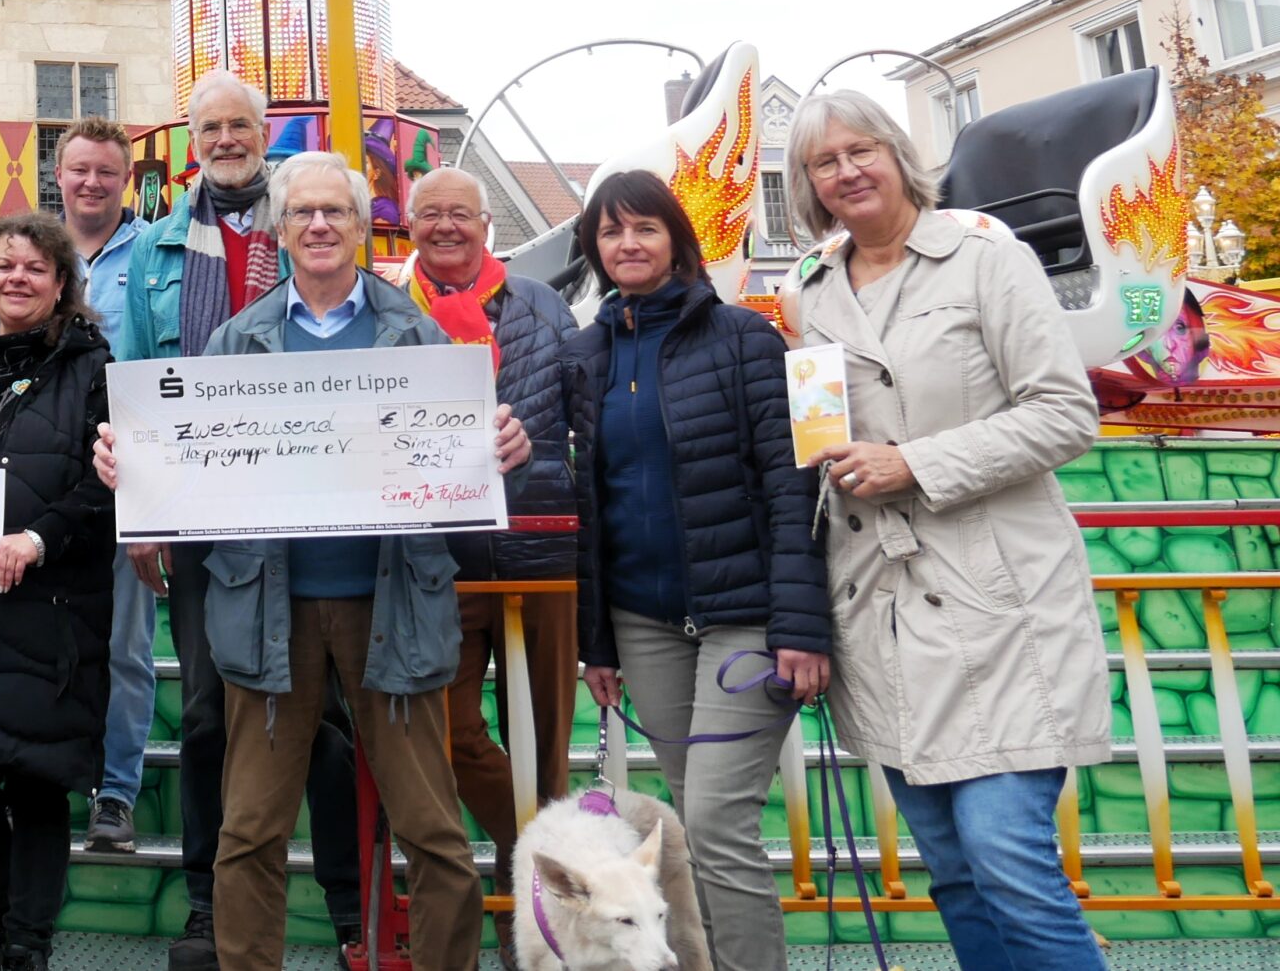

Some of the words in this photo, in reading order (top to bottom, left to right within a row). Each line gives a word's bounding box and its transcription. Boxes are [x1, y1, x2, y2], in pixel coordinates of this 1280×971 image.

[194, 379, 288, 401] Sparkasse
[294, 380, 315, 393] an
[321, 376, 352, 392] der
[358, 374, 409, 393] Lippe
[174, 411, 336, 440] Zweitausend
[410, 409, 476, 428] 2.000
[180, 443, 271, 467] Hospizgruppe
[276, 439, 320, 456] Werne
[406, 453, 455, 468] 2024
